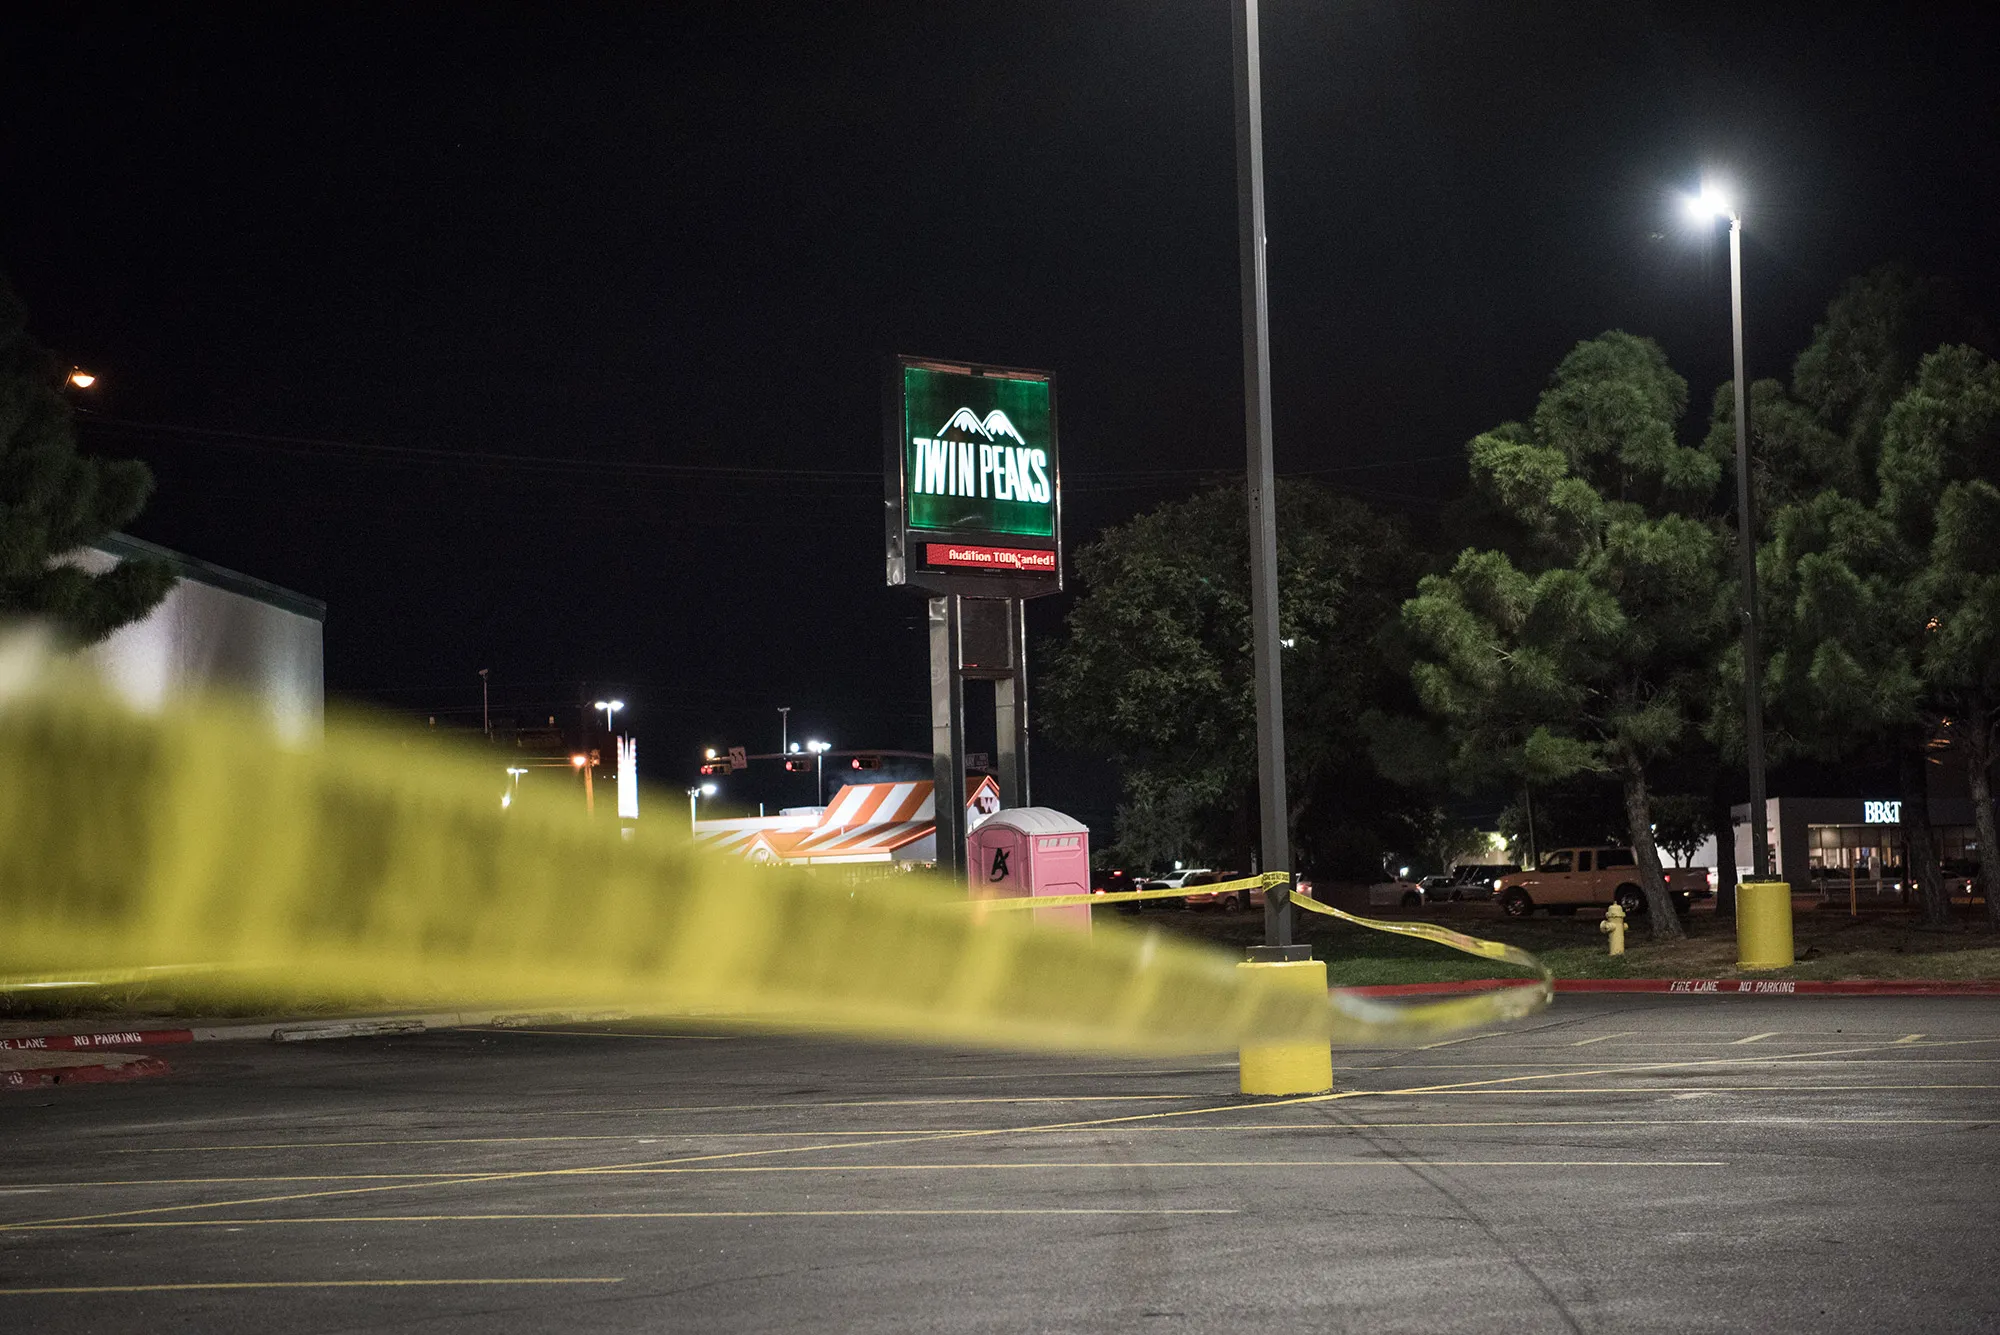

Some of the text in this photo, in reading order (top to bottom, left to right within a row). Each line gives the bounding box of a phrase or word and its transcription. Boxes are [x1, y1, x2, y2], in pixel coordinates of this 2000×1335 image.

[912, 437, 1051, 504] TWIN PEAKS
[948, 549, 991, 562] Audition
[1864, 801, 1902, 823] BB&T
[1694, 981, 1719, 992] LANE
[1738, 981, 1795, 993] NO PARKING
[18, 1037, 48, 1049] LANE
[73, 1032, 142, 1046] NO PARKING
